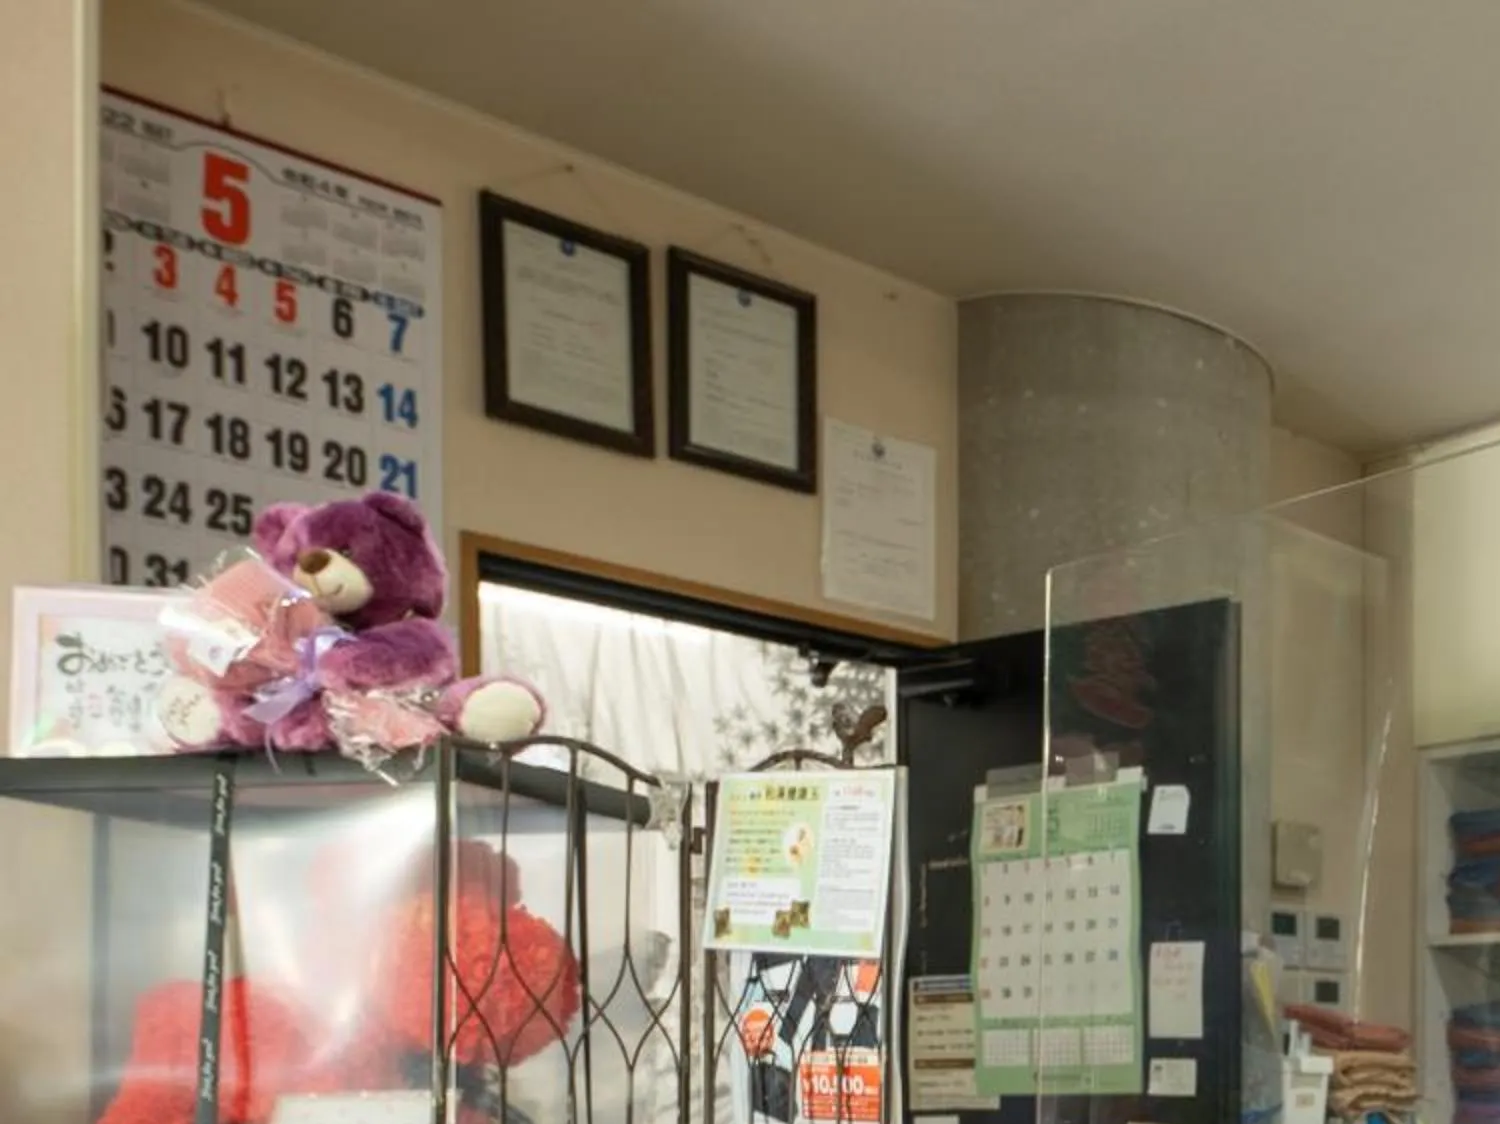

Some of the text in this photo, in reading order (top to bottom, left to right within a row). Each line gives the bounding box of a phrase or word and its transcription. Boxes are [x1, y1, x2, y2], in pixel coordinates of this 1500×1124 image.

[202, 151, 252, 247] 5
[154, 243, 409, 353] 3 4 5 6 7
[143, 321, 419, 428] 10 11 12 13 14
[144, 402, 190, 445] 17
[206, 414, 251, 460] 18
[266, 428, 310, 474] 19
[323, 441, 368, 487] 20
[379, 455, 418, 498] 21
[143, 476, 192, 524] 24
[206, 489, 254, 536] 25
